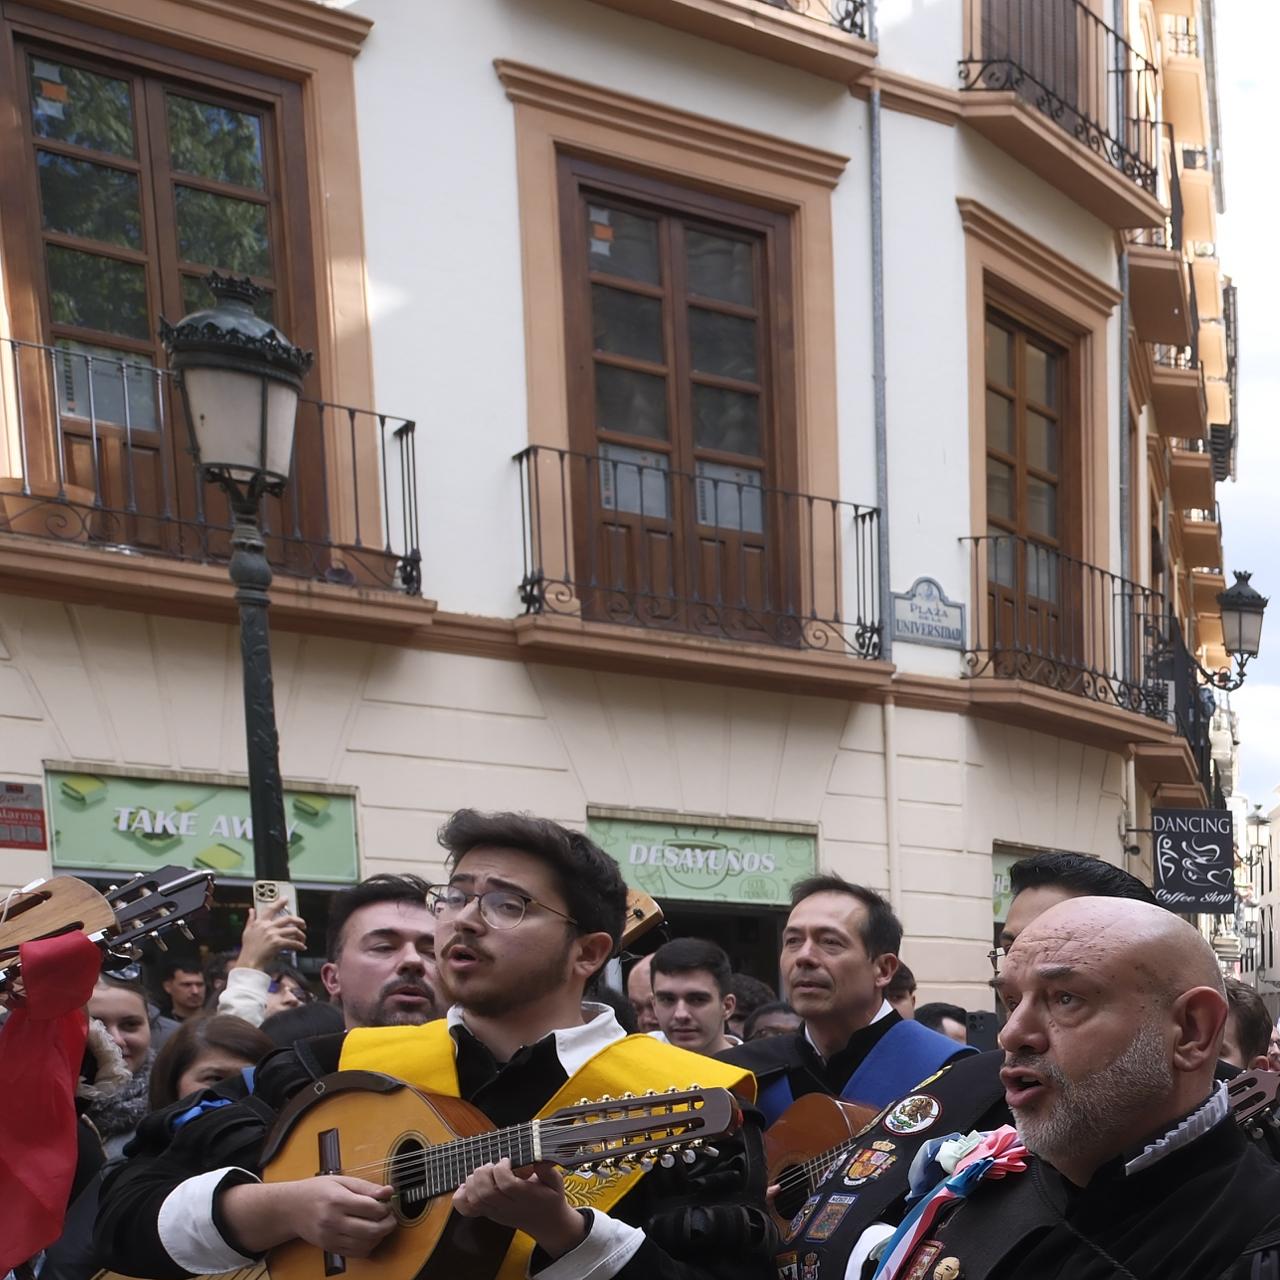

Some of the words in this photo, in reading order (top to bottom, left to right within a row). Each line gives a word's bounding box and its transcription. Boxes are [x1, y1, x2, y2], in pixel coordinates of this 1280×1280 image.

[910, 602, 948, 618] PLAZA
[896, 619, 961, 641] UNIVERSIDAD
[114, 806, 198, 836] TAKE
[209, 815, 298, 843] AWY
[1153, 815, 1230, 834] DANCING
[629, 843, 776, 874] DESAYUNOS
[1155, 888, 1196, 904] Coffee
[1199, 891, 1232, 905] Shop
